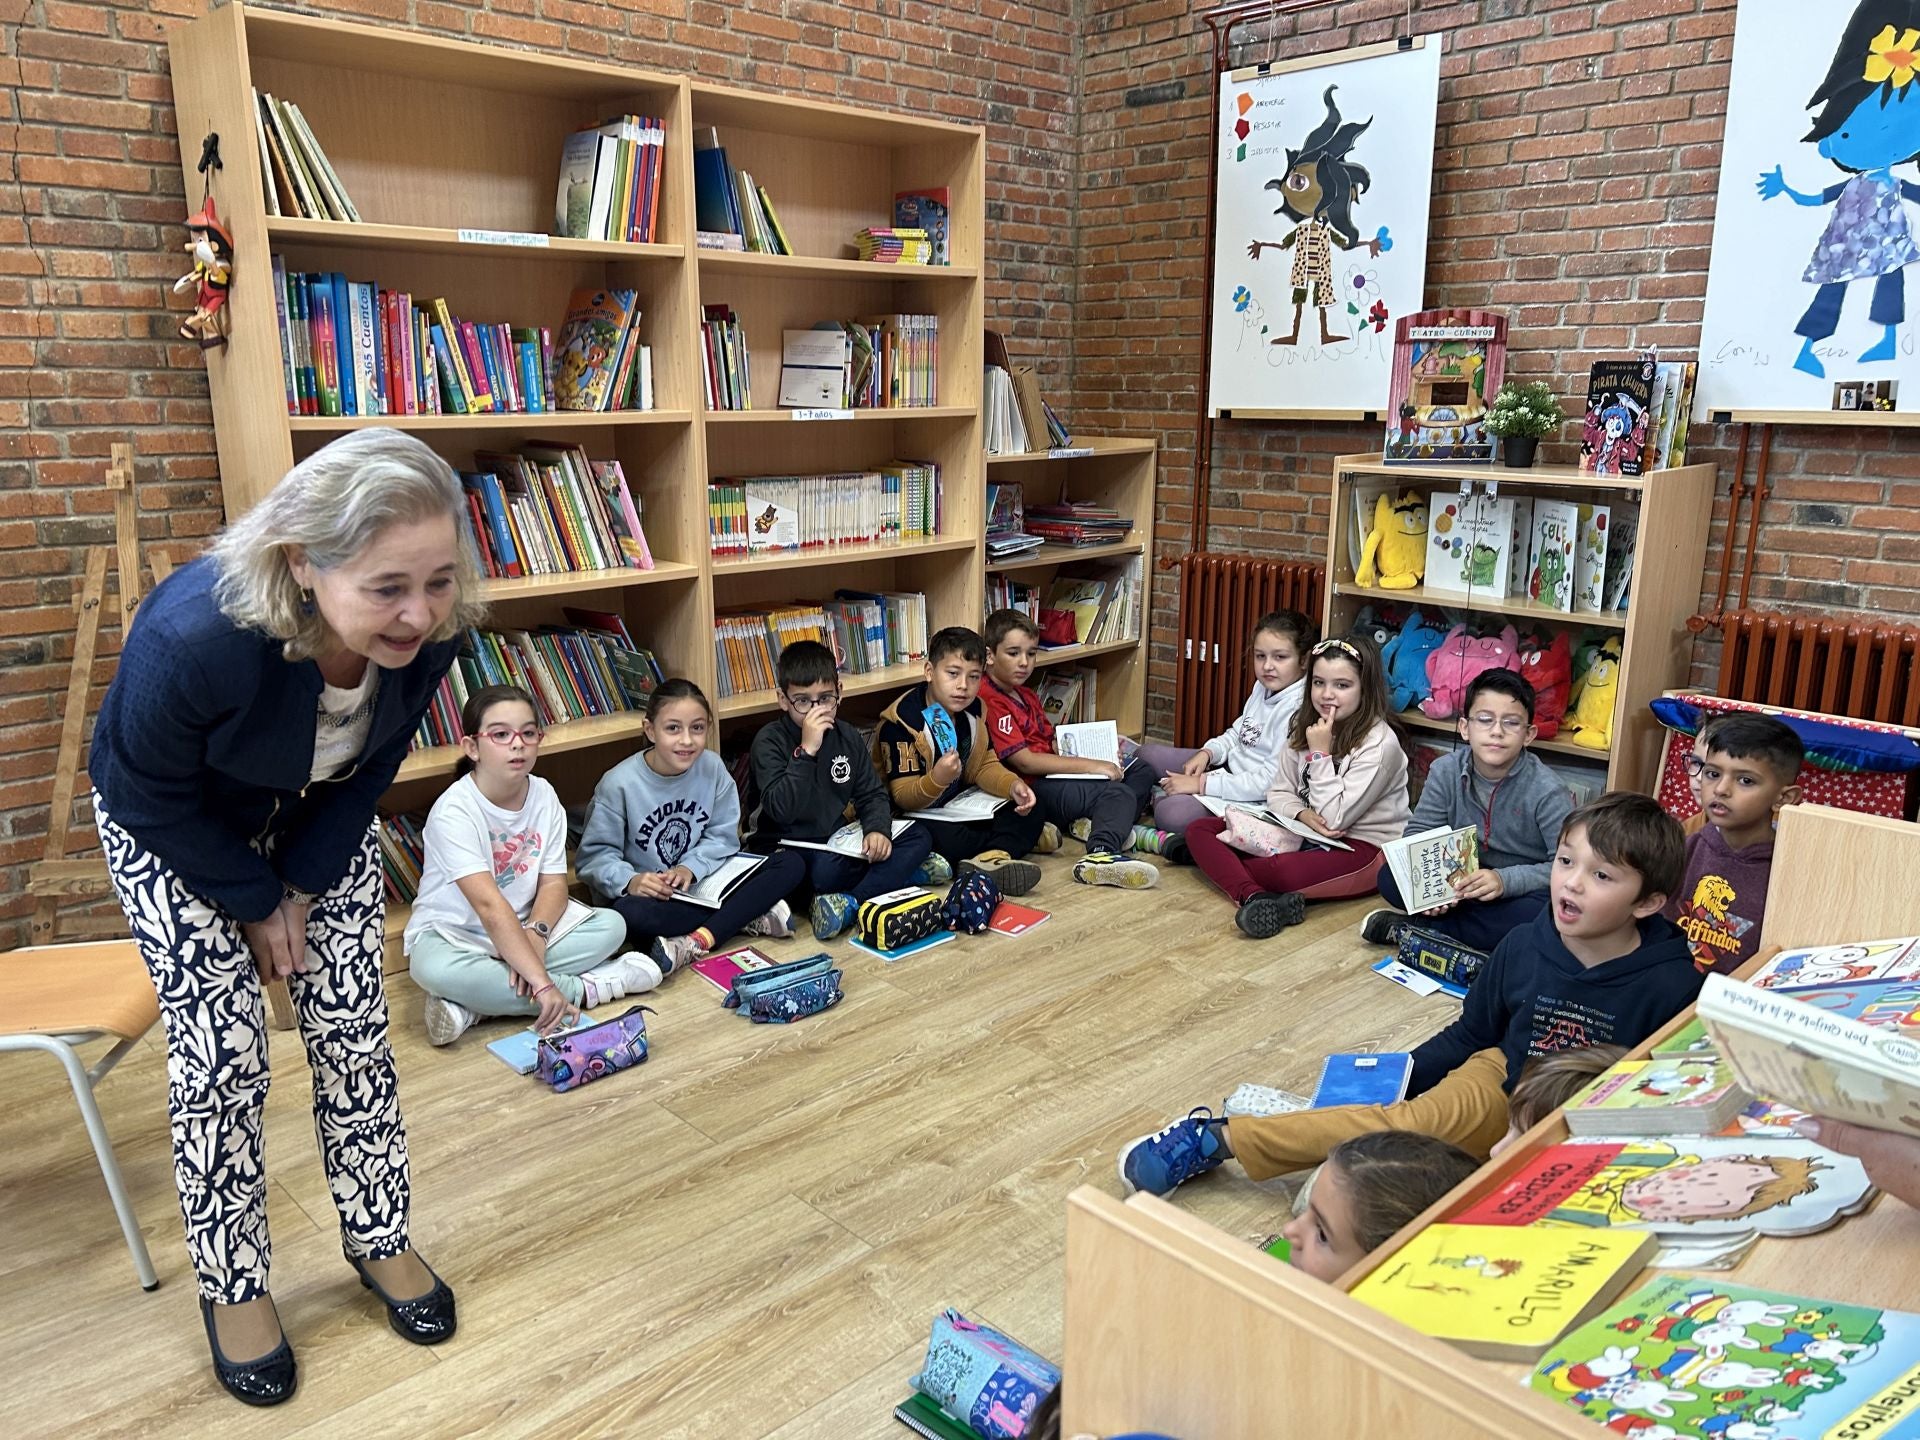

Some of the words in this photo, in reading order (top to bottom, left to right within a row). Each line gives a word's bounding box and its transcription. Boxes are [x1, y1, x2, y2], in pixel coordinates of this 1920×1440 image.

[361, 287, 372, 349] Cuentos
[1411, 329, 1445, 337] TEATRO
[1453, 329, 1493, 337] CUENTOS
[364, 354, 373, 377] 365
[1592, 374, 1618, 392] PIRATA
[1420, 847, 1432, 880] Quijote
[1429, 841, 1442, 877] Mancha
[1422, 881, 1432, 900] Don
[1432, 877, 1443, 887] la
[1433, 887, 1443, 898] de
[1537, 995, 1556, 1005] Kappa
[1566, 1001, 1579, 1009] The
[1579, 1005, 1616, 1021] sportswear
[1722, 988, 1766, 1014] Mancha
[1768, 1003, 1780, 1016] la
[1534, 1003, 1552, 1013] brand
[1553, 1008, 1586, 1022] dedicated
[1594, 1020, 1614, 1031] active
[1783, 1008, 1797, 1023] de
[1798, 1014, 1843, 1037] Quijote
[1845, 1029, 1870, 1046] Don
[1508, 1242, 1611, 1327] AMARILLO
